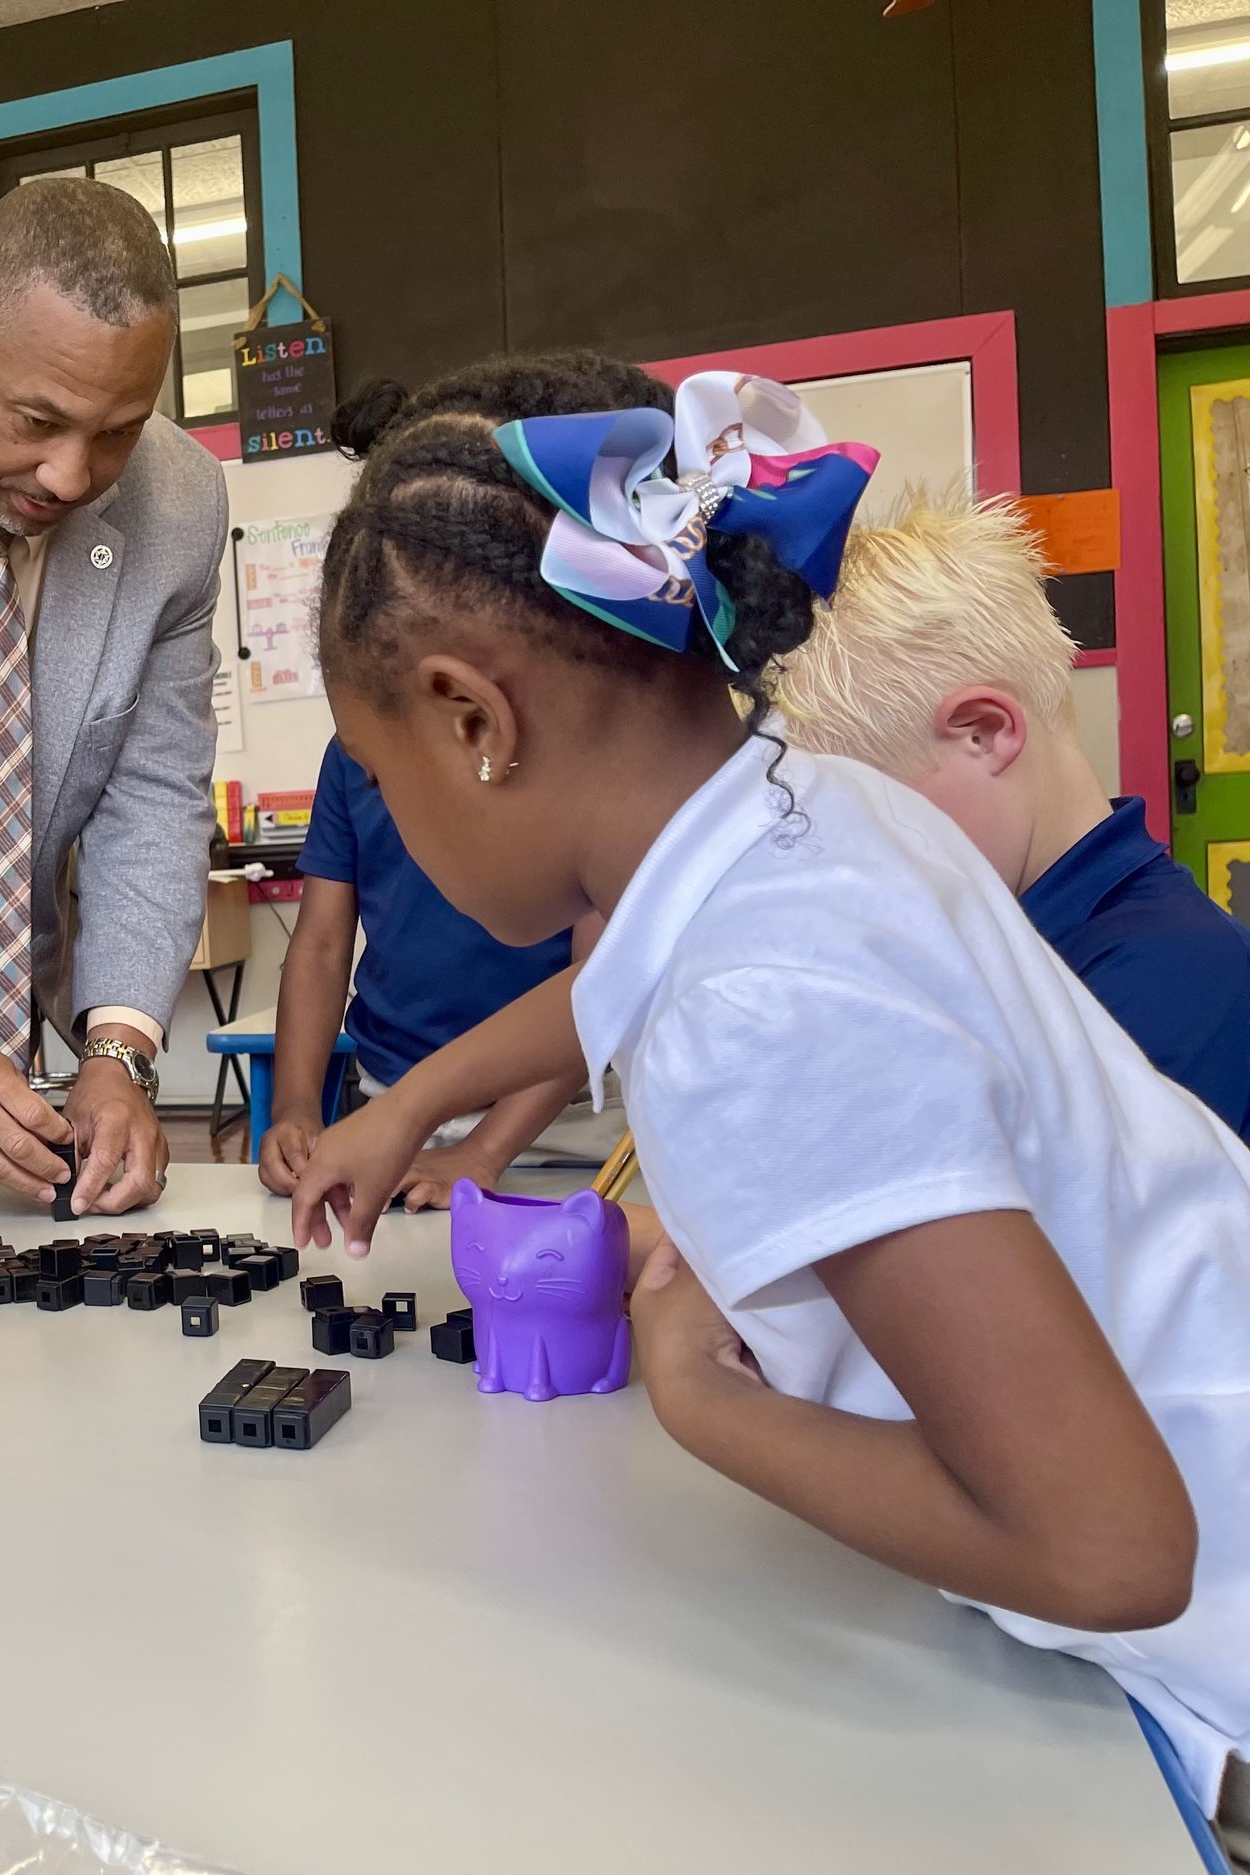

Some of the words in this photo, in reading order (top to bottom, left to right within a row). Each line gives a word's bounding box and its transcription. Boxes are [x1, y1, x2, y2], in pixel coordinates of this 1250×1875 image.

[241, 337, 326, 367] Listen
[285, 365, 305, 378] the
[256, 406, 294, 421] letters
[247, 427, 332, 453] silent.
